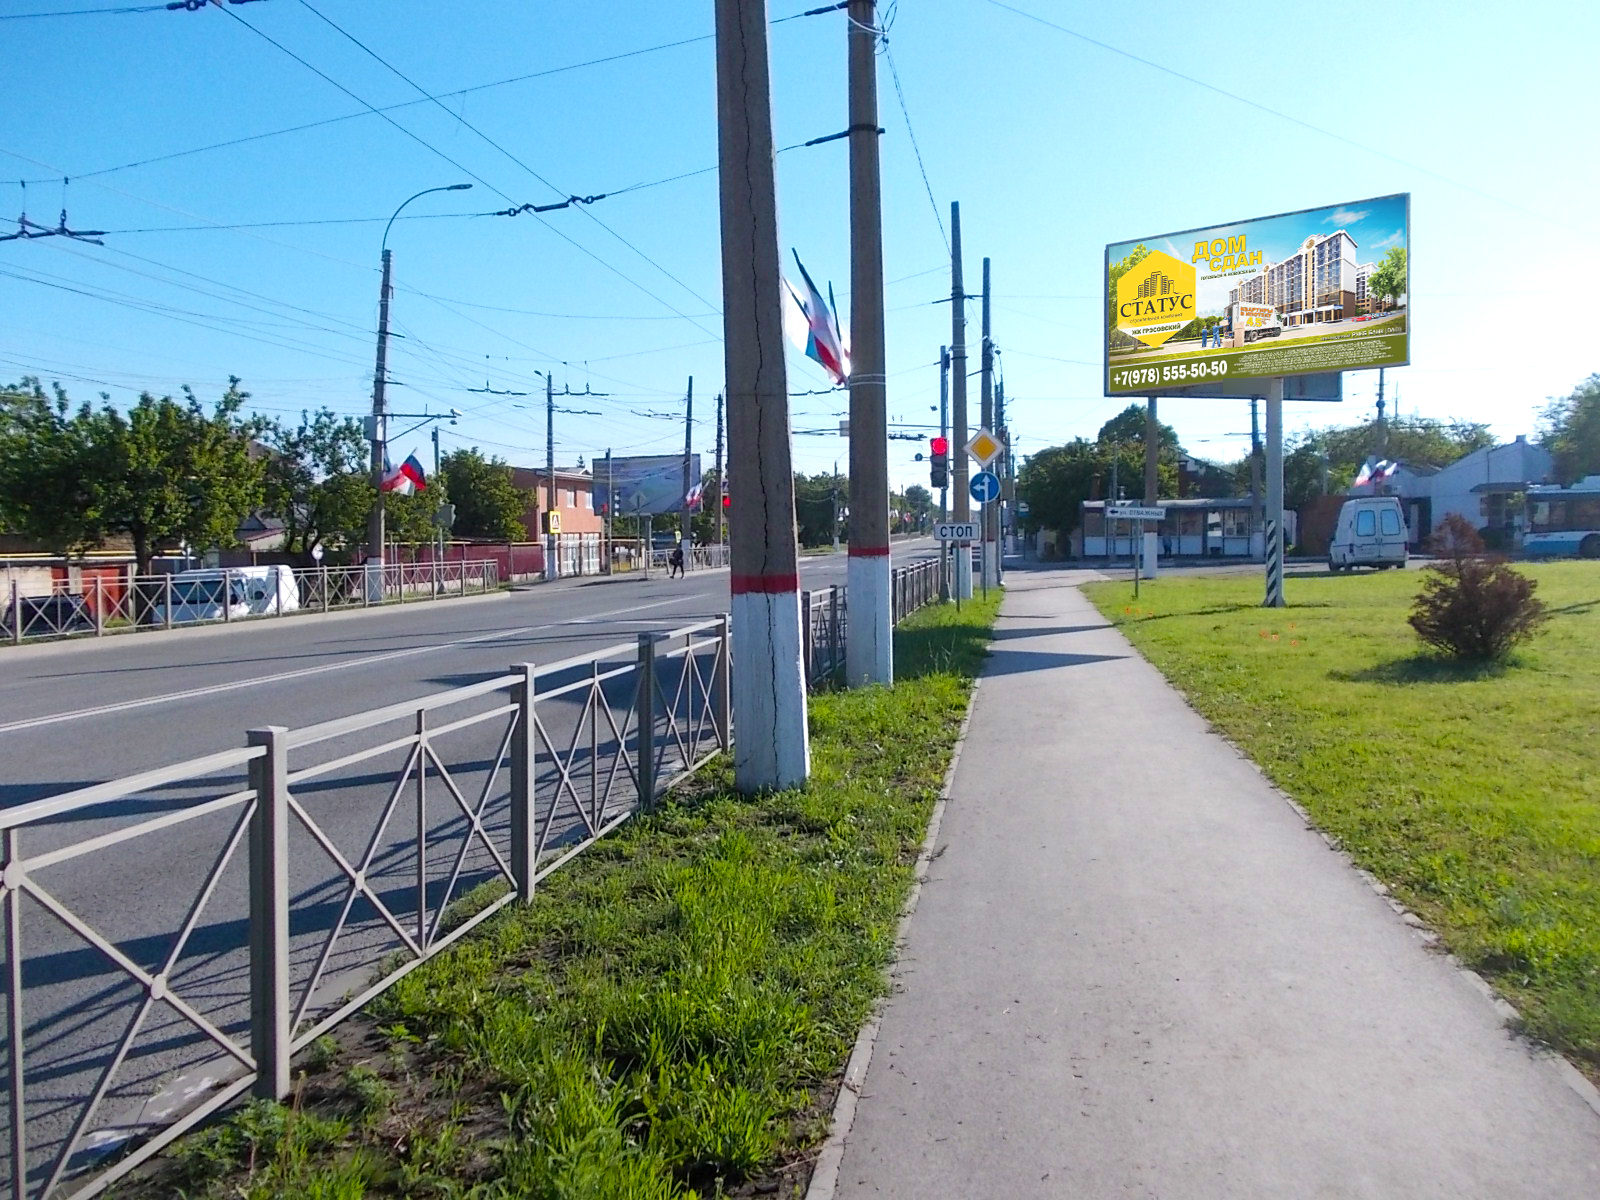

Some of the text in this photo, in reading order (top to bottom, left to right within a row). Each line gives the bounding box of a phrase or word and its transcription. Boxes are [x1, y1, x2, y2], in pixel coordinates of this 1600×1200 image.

[1192, 234, 1247, 263] ДОМ
[1209, 250, 1262, 272] СДАН
[1120, 294, 1193, 318] СТАТУС
[1142, 323, 1181, 334] ГРЭСОВСКИЙ
[1113, 360, 1228, 387] +7(978) 555-50-50
[940, 525, 973, 538] СТОП
